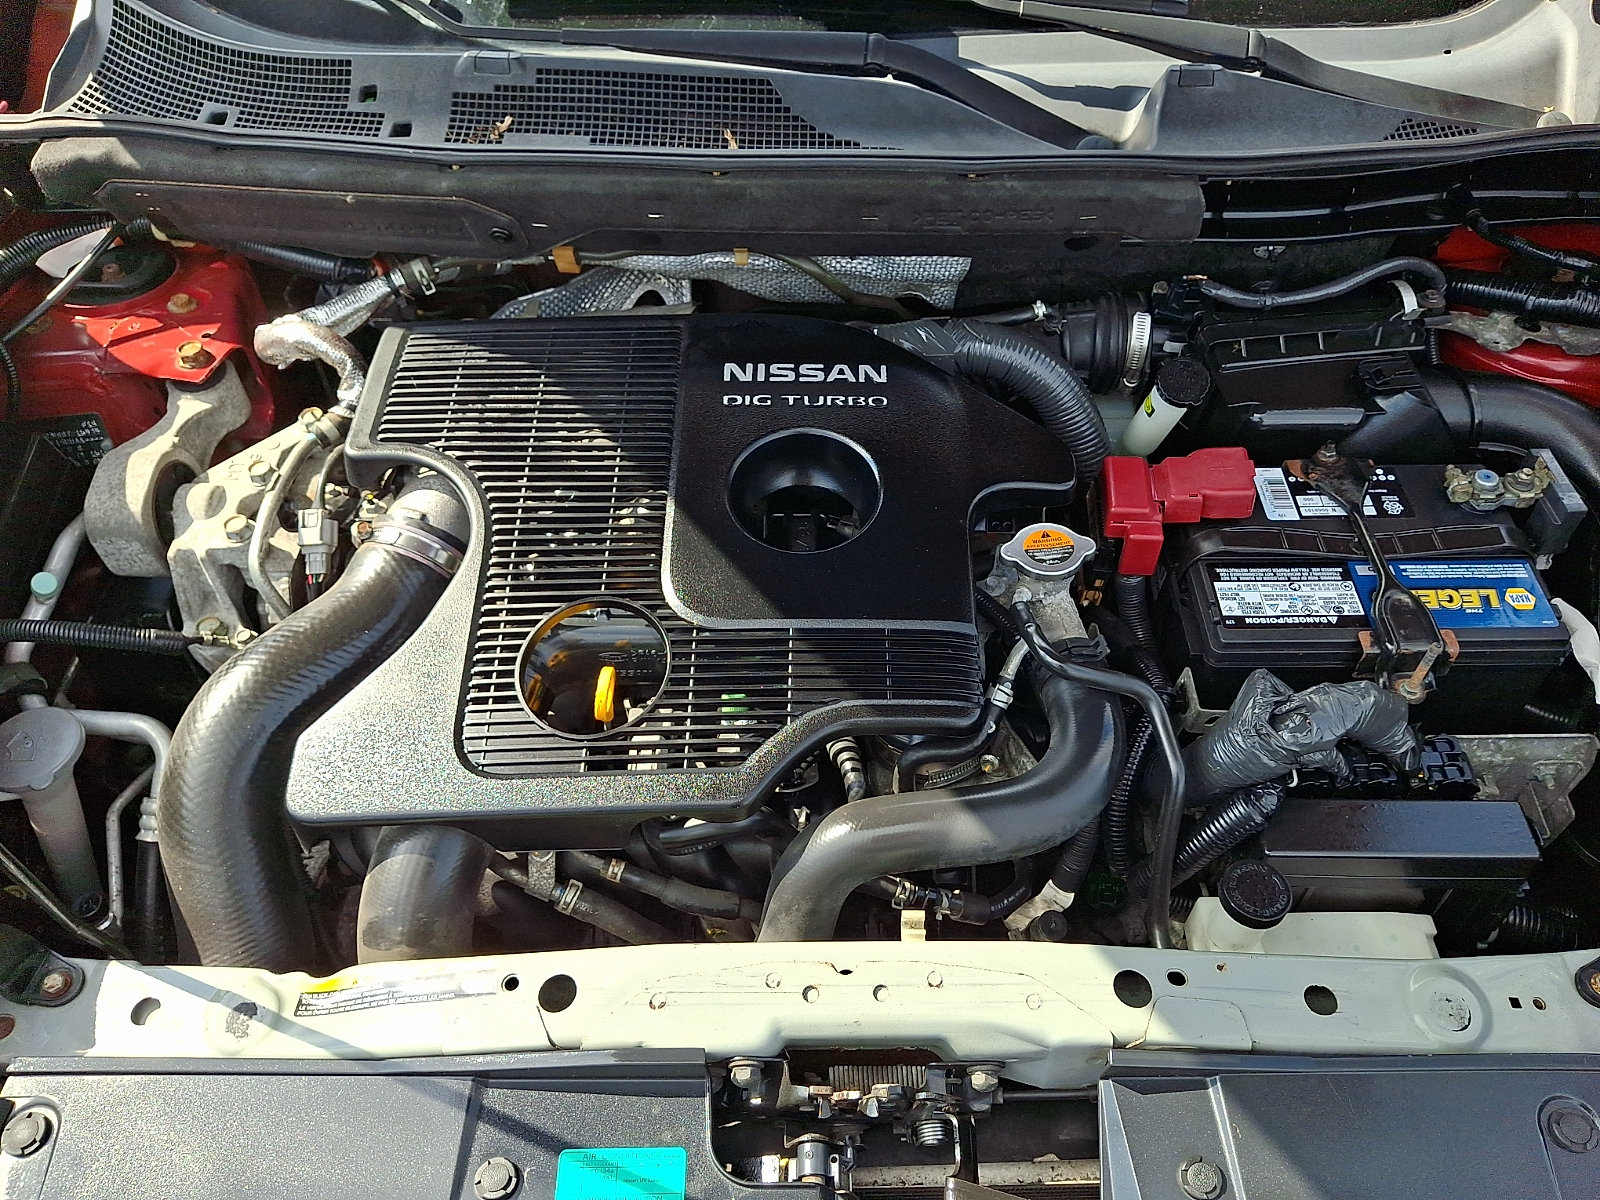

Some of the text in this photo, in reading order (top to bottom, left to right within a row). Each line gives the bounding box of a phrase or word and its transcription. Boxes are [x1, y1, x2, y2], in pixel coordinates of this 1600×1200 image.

[723, 362, 887, 382] NISSAN
[722, 394, 888, 407] DIG TURBO
[1411, 588, 1501, 610] LEGE
[1508, 594, 1532, 603] NAPA
[1245, 616, 1329, 624] DANGER/POISON
